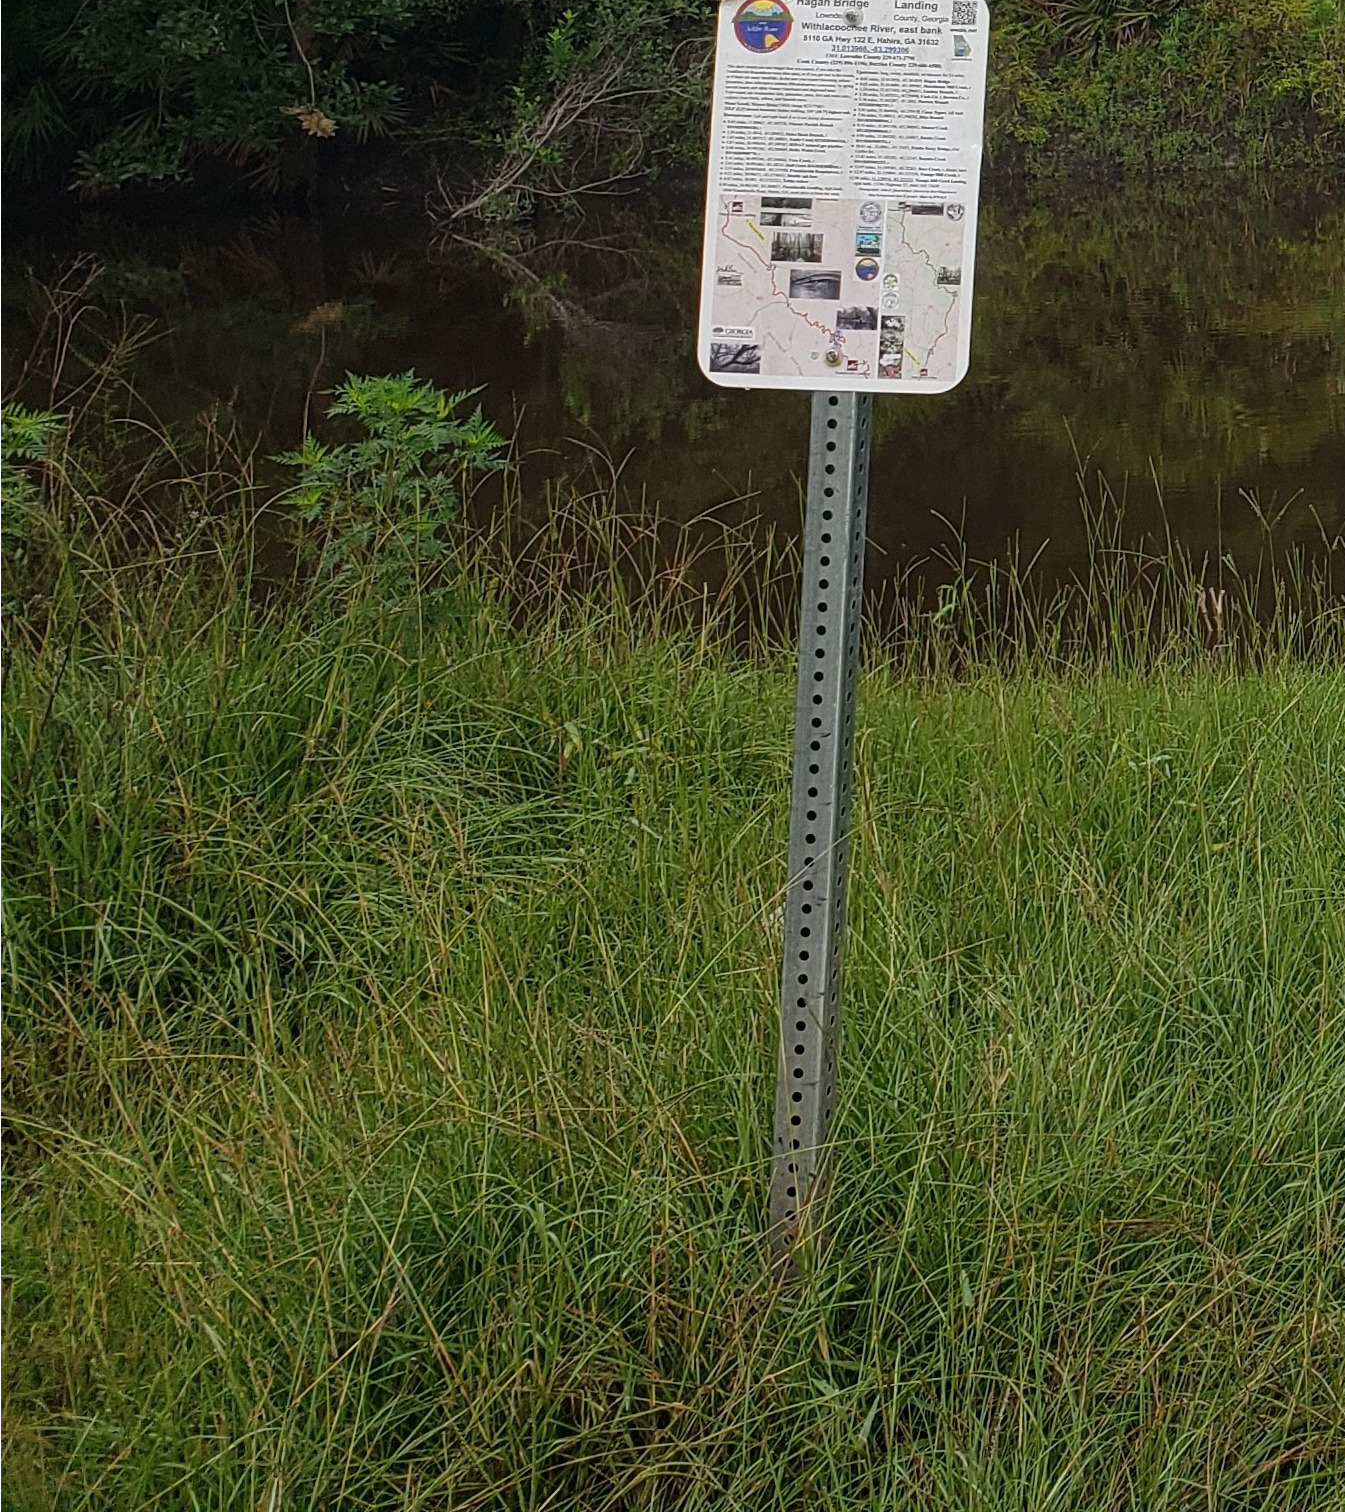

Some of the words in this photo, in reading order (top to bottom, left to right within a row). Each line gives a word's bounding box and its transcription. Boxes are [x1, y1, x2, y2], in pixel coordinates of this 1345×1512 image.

[894, 0, 938, 12] Landing
[894, 14, 920, 23] County,
[922, 16, 948, 24] Georgia
[802, 22, 868, 32] Withlacoochee
[870, 25, 896, 34] River,
[898, 26, 918, 34] east
[920, 26, 942, 34] bank
[836, 36, 850, 44] Hwy
[854, 36, 866, 44] 122
